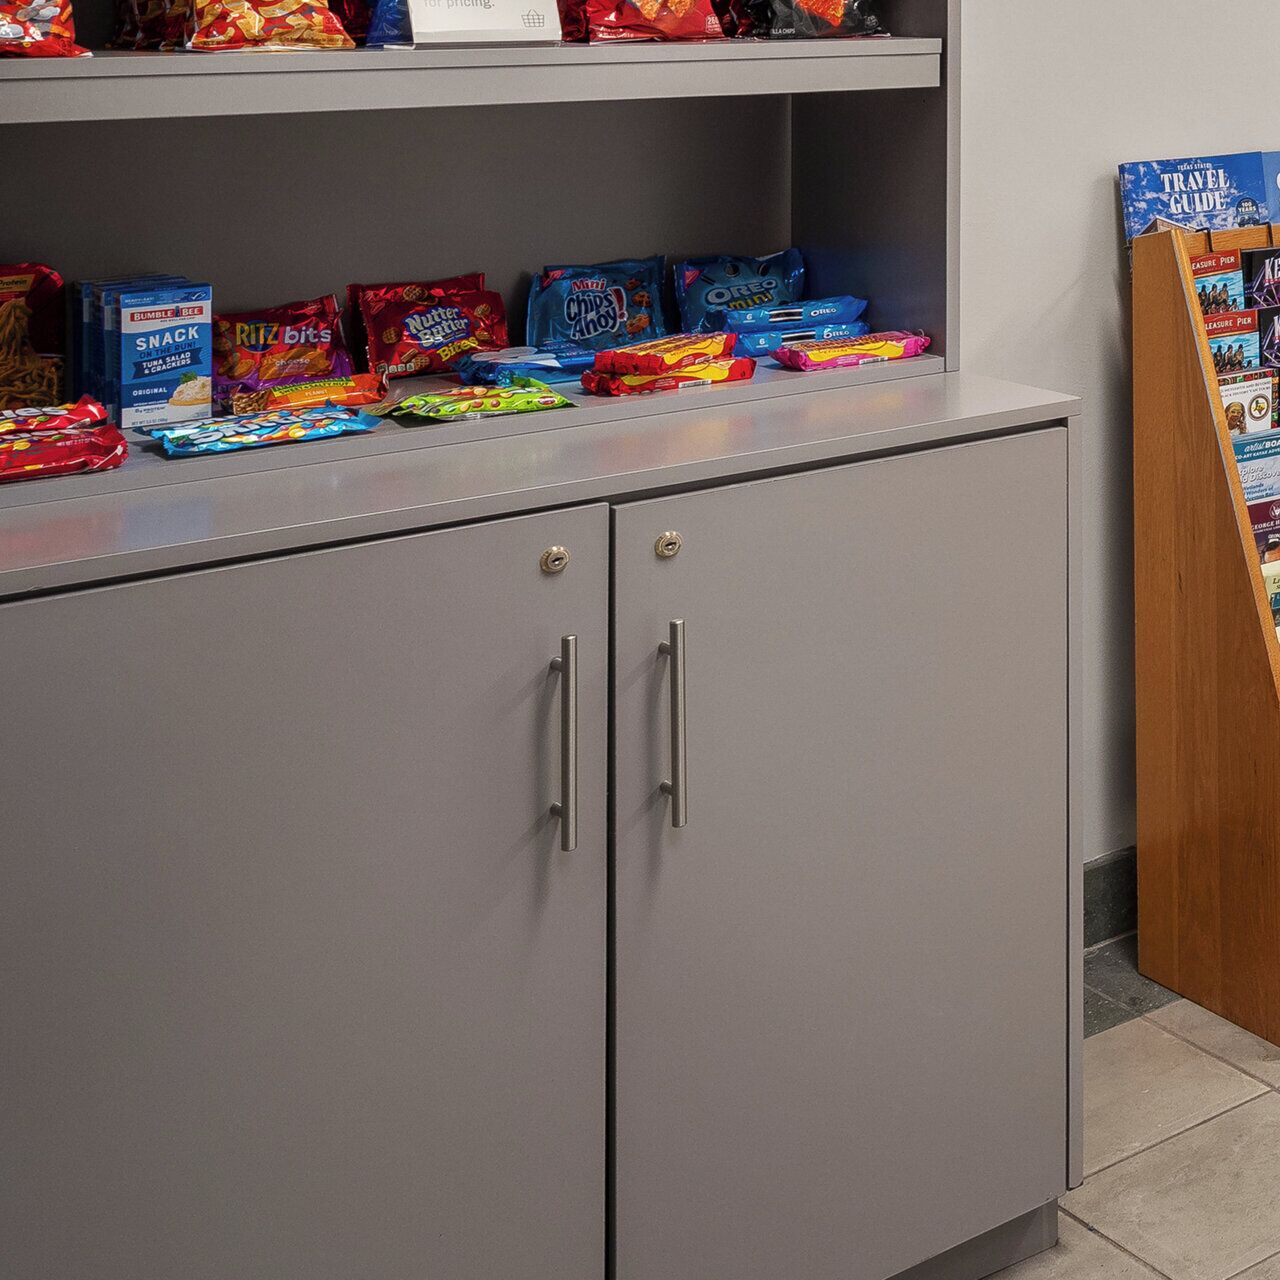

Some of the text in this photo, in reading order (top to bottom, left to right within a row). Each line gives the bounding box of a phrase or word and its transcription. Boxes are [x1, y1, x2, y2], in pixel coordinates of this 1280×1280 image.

[1160, 169, 1229, 192] TRAVEL
[1170, 191, 1227, 214] GUIDE
[1238, 205, 1256, 213] YEARS
[571, 278, 606, 292] Mini
[706, 279, 777, 304] OREO
[565, 292, 615, 323] Chips
[728, 292, 773, 310] mini
[133, 307, 201, 321] BUMBLE BEE
[405, 306, 460, 333] Nutter
[135, 325, 199, 350] SNACK
[235, 322, 331, 345] RITZ bits
[139, 342, 196, 358] ON THE RUN!
[165, 353, 191, 362] SALAD
[437, 337, 479, 361] Bites
[150, 357, 191, 373] CRACKERS
[132, 387, 167, 396] ORIGINAL
